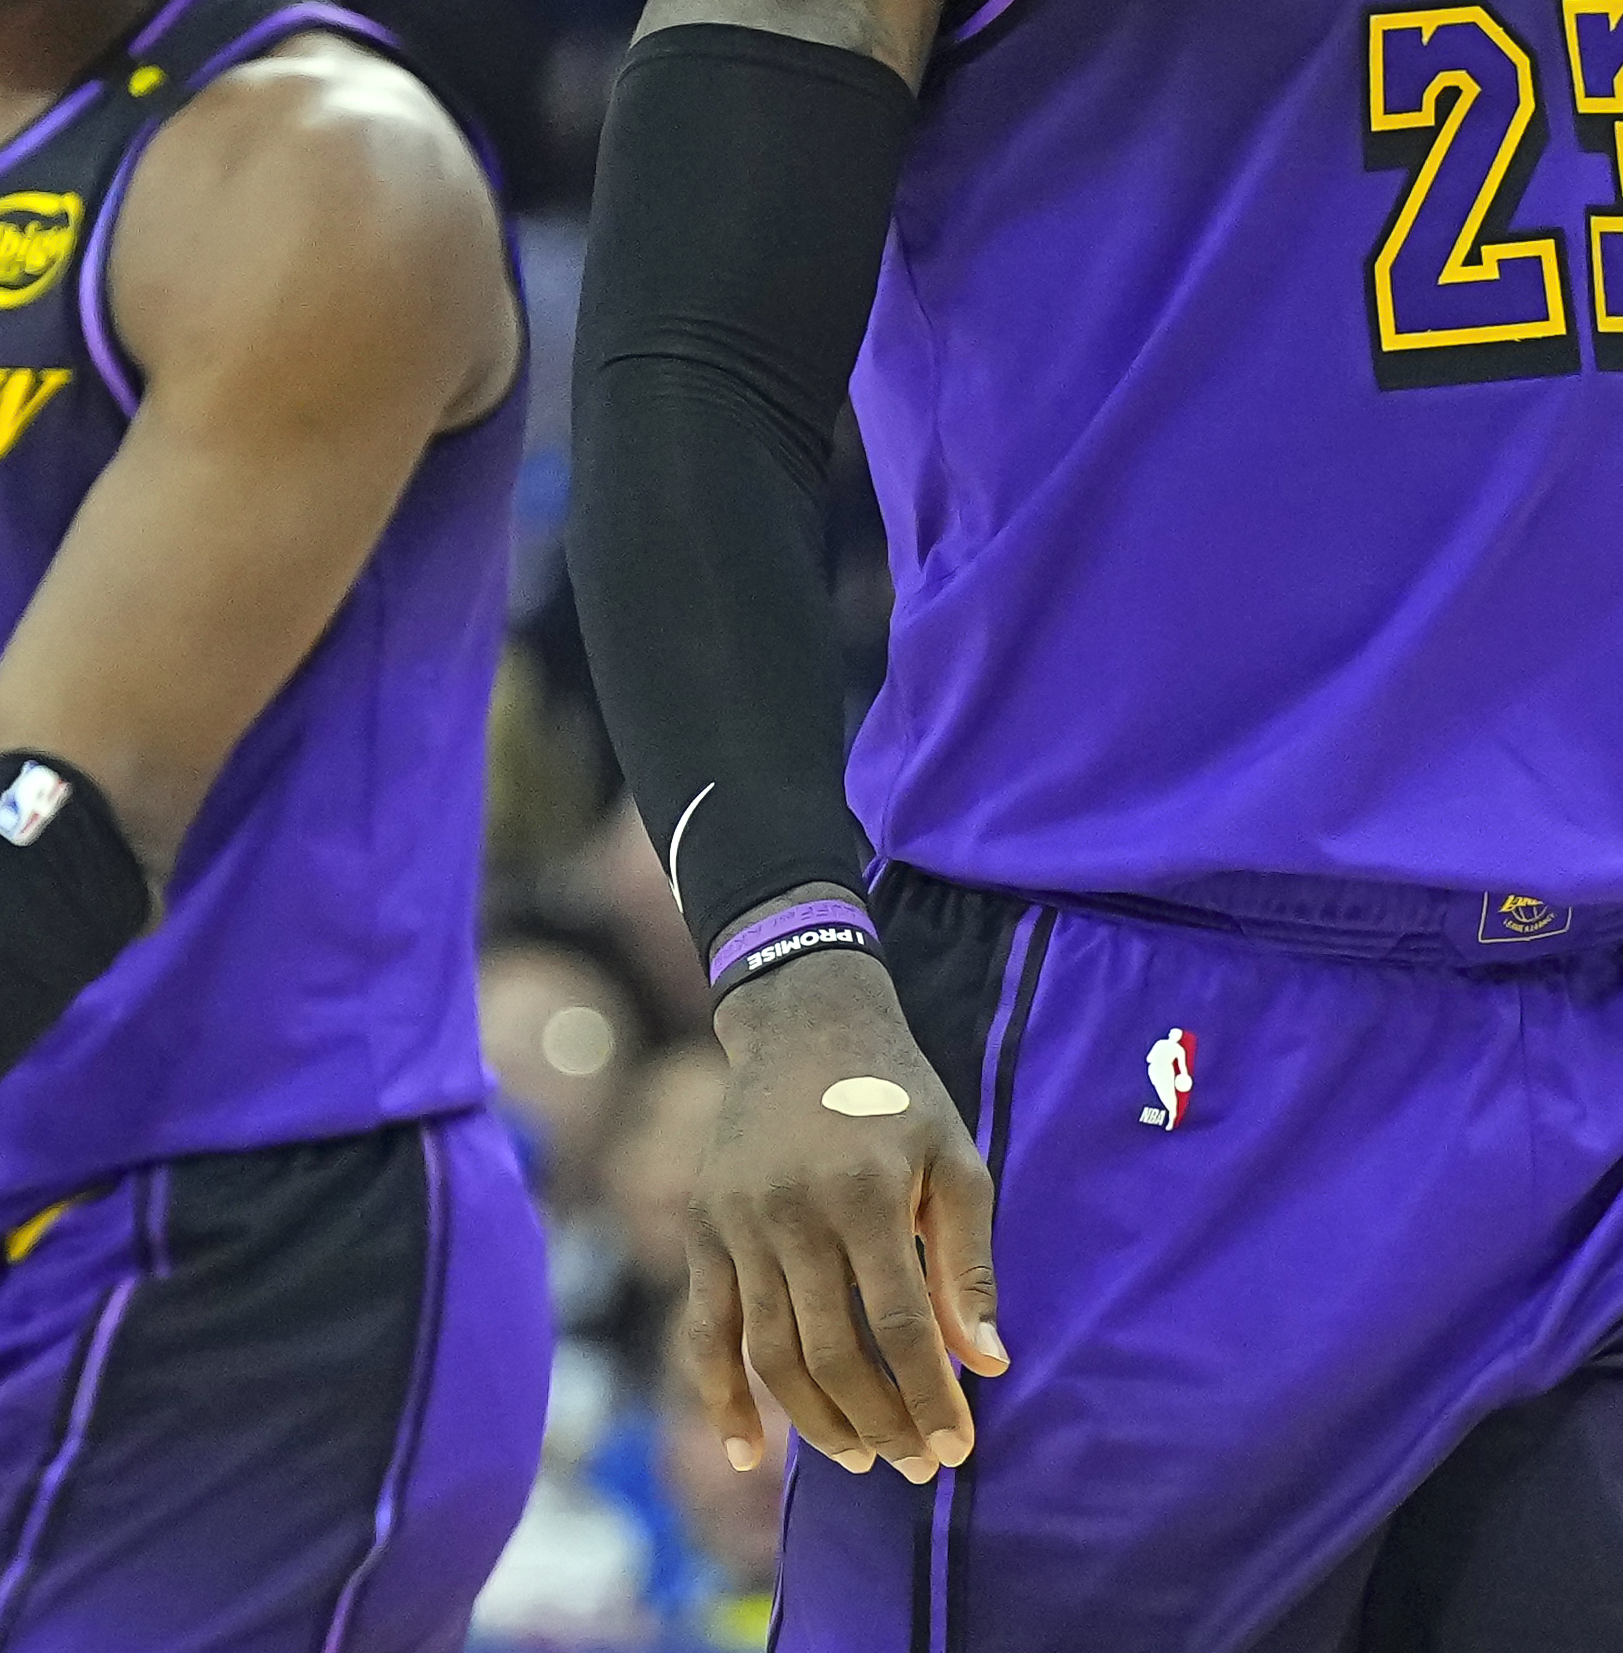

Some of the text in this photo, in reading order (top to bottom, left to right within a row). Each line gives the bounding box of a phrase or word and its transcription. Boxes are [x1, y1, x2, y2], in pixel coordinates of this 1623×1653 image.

[857, 931, 865, 946] I
[746, 928, 854, 971] PROMISE
[1139, 1106, 1167, 1126] NBA
